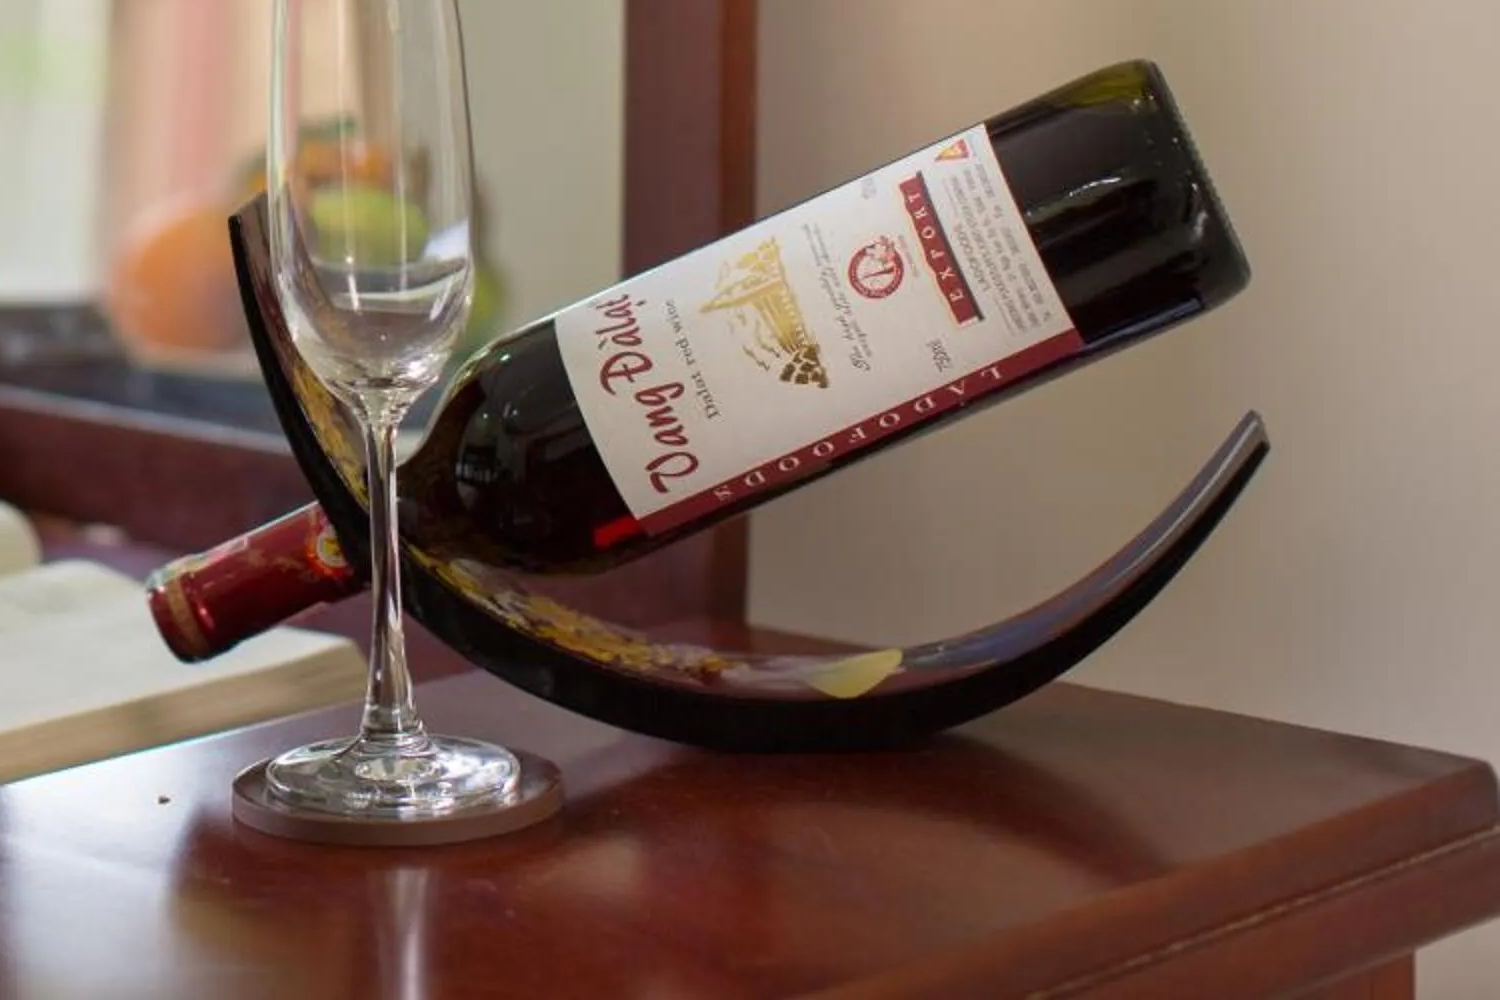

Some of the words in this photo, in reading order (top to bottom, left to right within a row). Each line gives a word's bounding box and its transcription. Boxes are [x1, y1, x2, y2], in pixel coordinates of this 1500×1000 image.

[904, 190, 963, 301] EXPORT
[664, 298, 682, 333] wine
[674, 337, 696, 366] red
[689, 371, 719, 419] Dalat
[713, 363, 1004, 503] LADOFOODS
